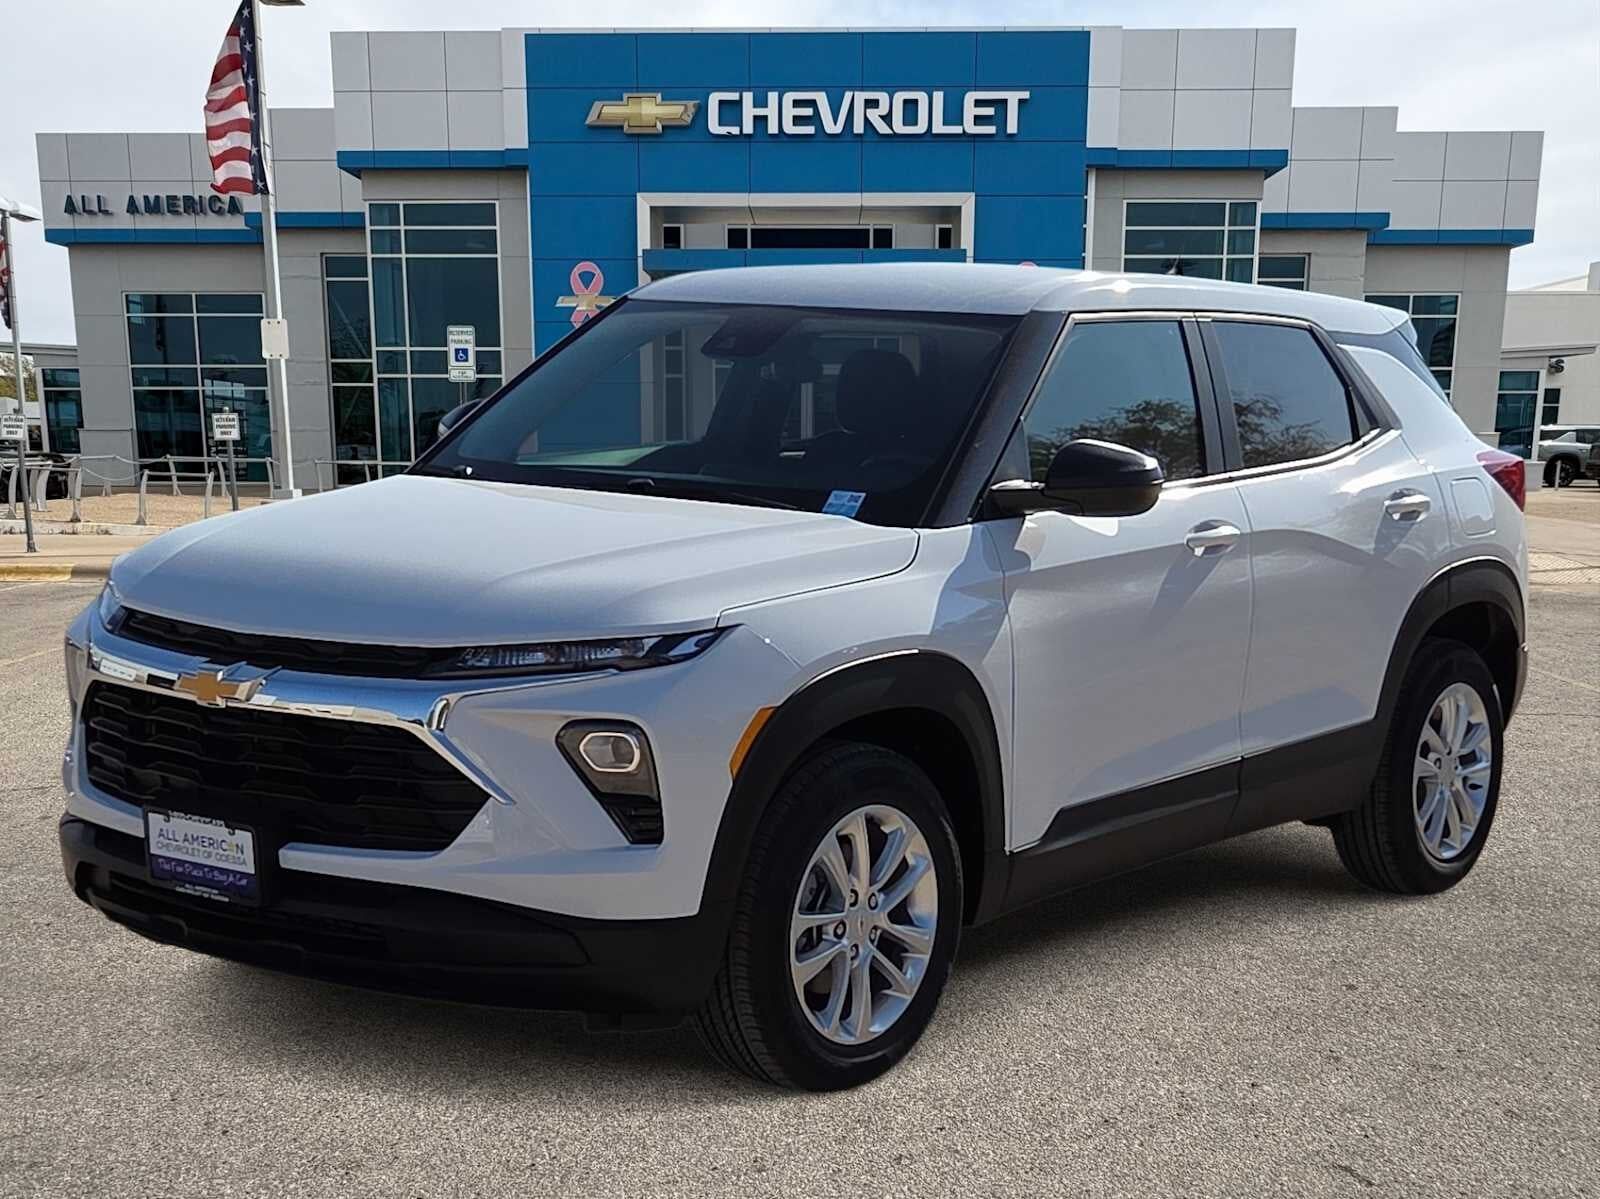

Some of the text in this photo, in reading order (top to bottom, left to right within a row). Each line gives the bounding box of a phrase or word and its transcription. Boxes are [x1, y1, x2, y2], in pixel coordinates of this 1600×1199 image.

[707, 90, 1030, 136] CHEVROLET
[64, 194, 113, 216] ALL
[157, 827, 180, 843] ALL
[156, 840, 248, 866] CHEVROLET OF ODESSA
